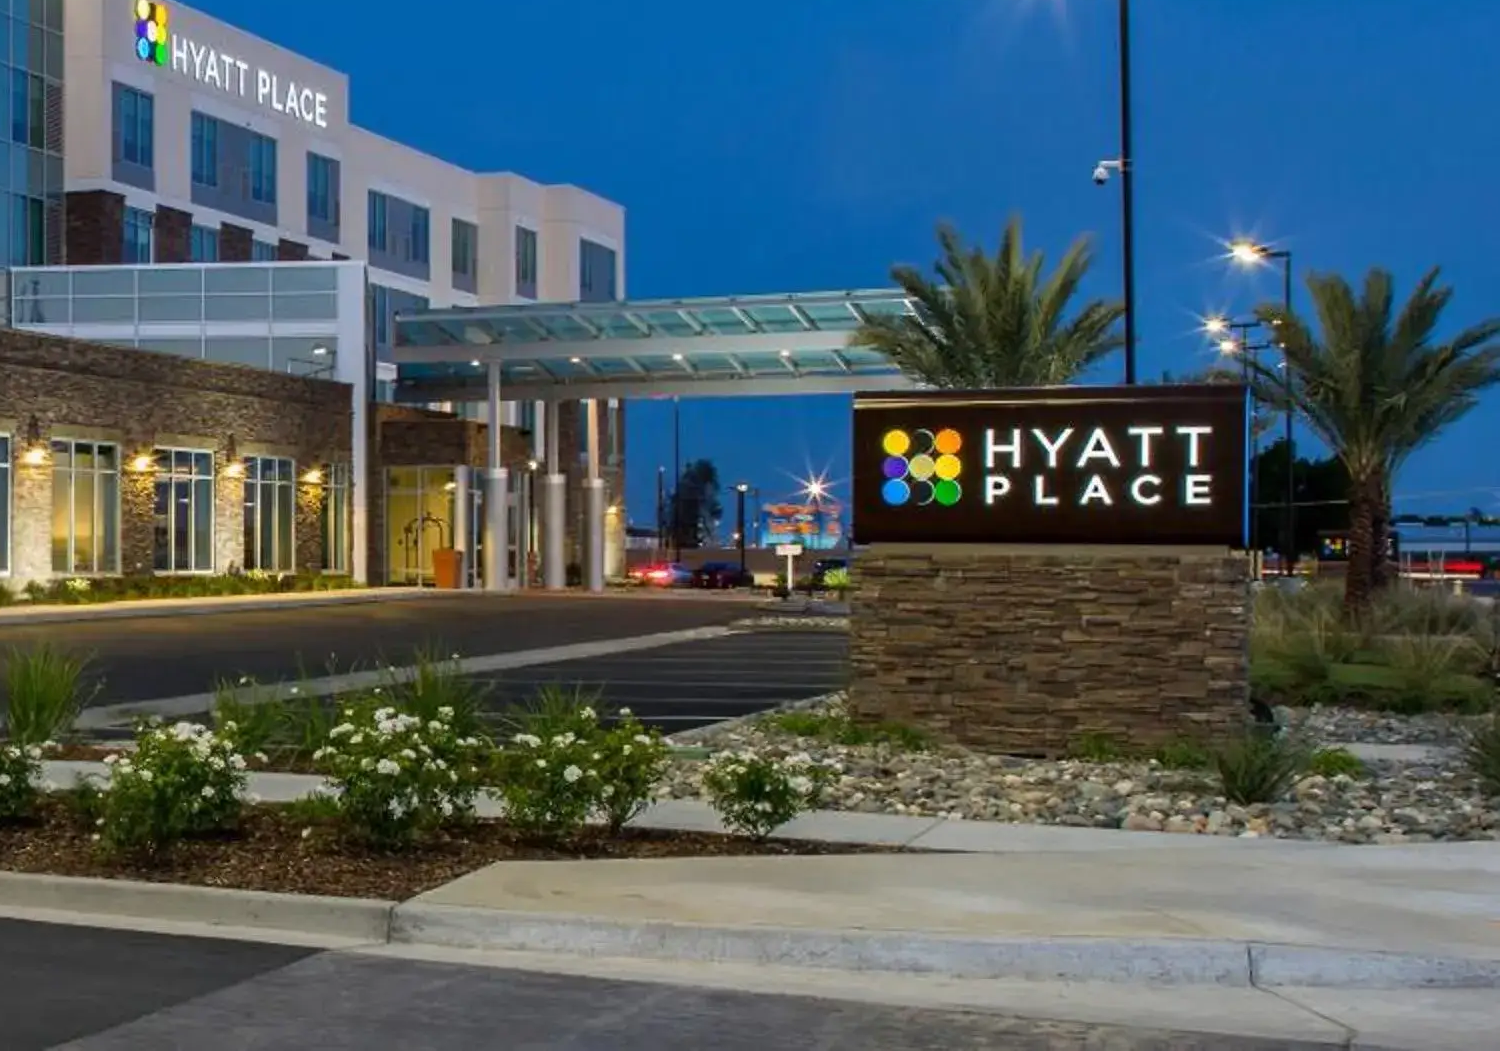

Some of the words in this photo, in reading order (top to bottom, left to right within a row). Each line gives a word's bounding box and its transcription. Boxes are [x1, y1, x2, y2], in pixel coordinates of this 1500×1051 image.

[171, 34, 249, 96] HYATT
[257, 69, 328, 128] PLACE
[986, 427, 1211, 467] HYATT
[986, 475, 1211, 505] PLACE
